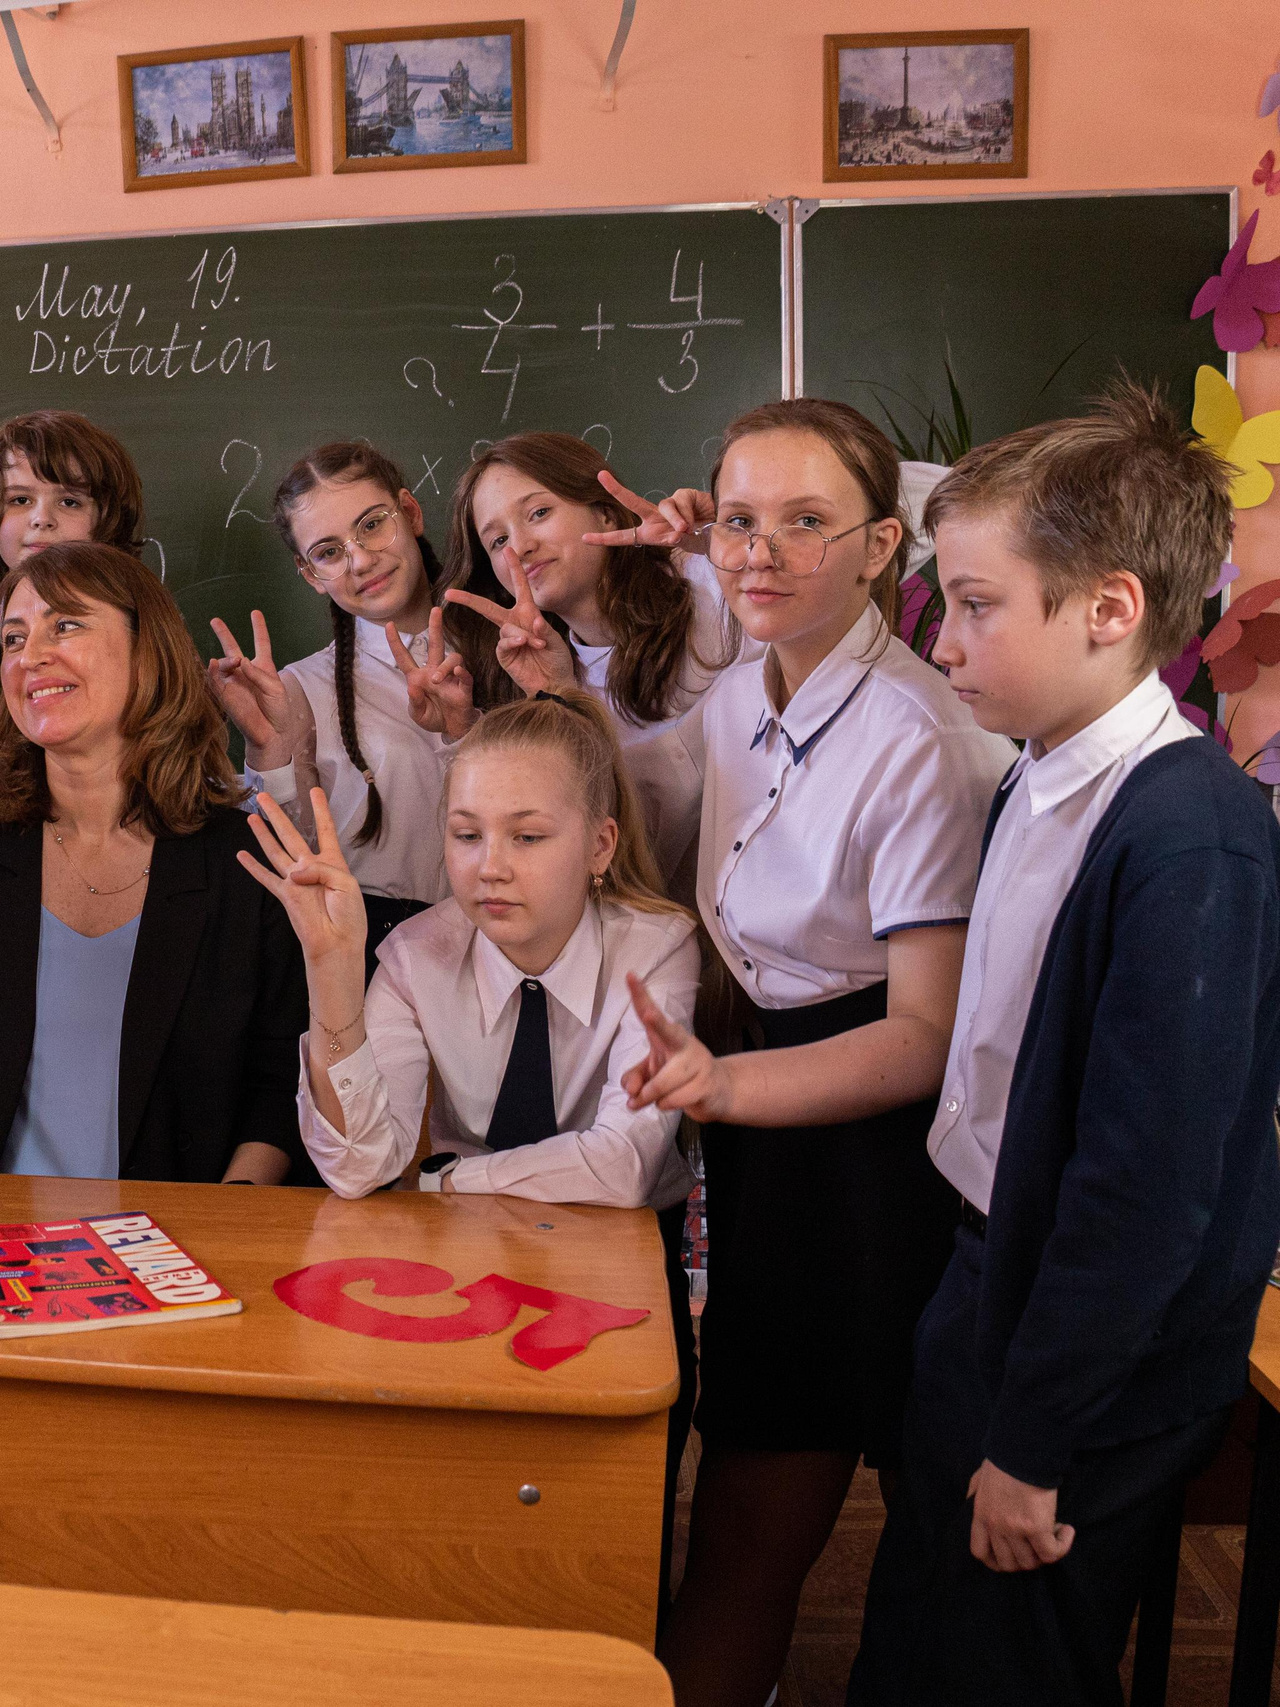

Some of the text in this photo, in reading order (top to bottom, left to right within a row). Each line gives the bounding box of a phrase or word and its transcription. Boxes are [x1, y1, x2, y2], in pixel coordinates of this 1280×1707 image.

[15, 246, 241, 336] May, 19.
[483, 253, 524, 326] 3
[670, 248, 704, 322] 4
[28, 321, 279, 379] Dictation
[480, 325, 521, 424] 4
[657, 329, 700, 394] 3
[220, 438, 276, 529] 2
[44, 1280, 117, 1291] Intermediate
[89, 1215, 222, 1304] REWARD
[142, 1271, 201, 1282] REWARD
